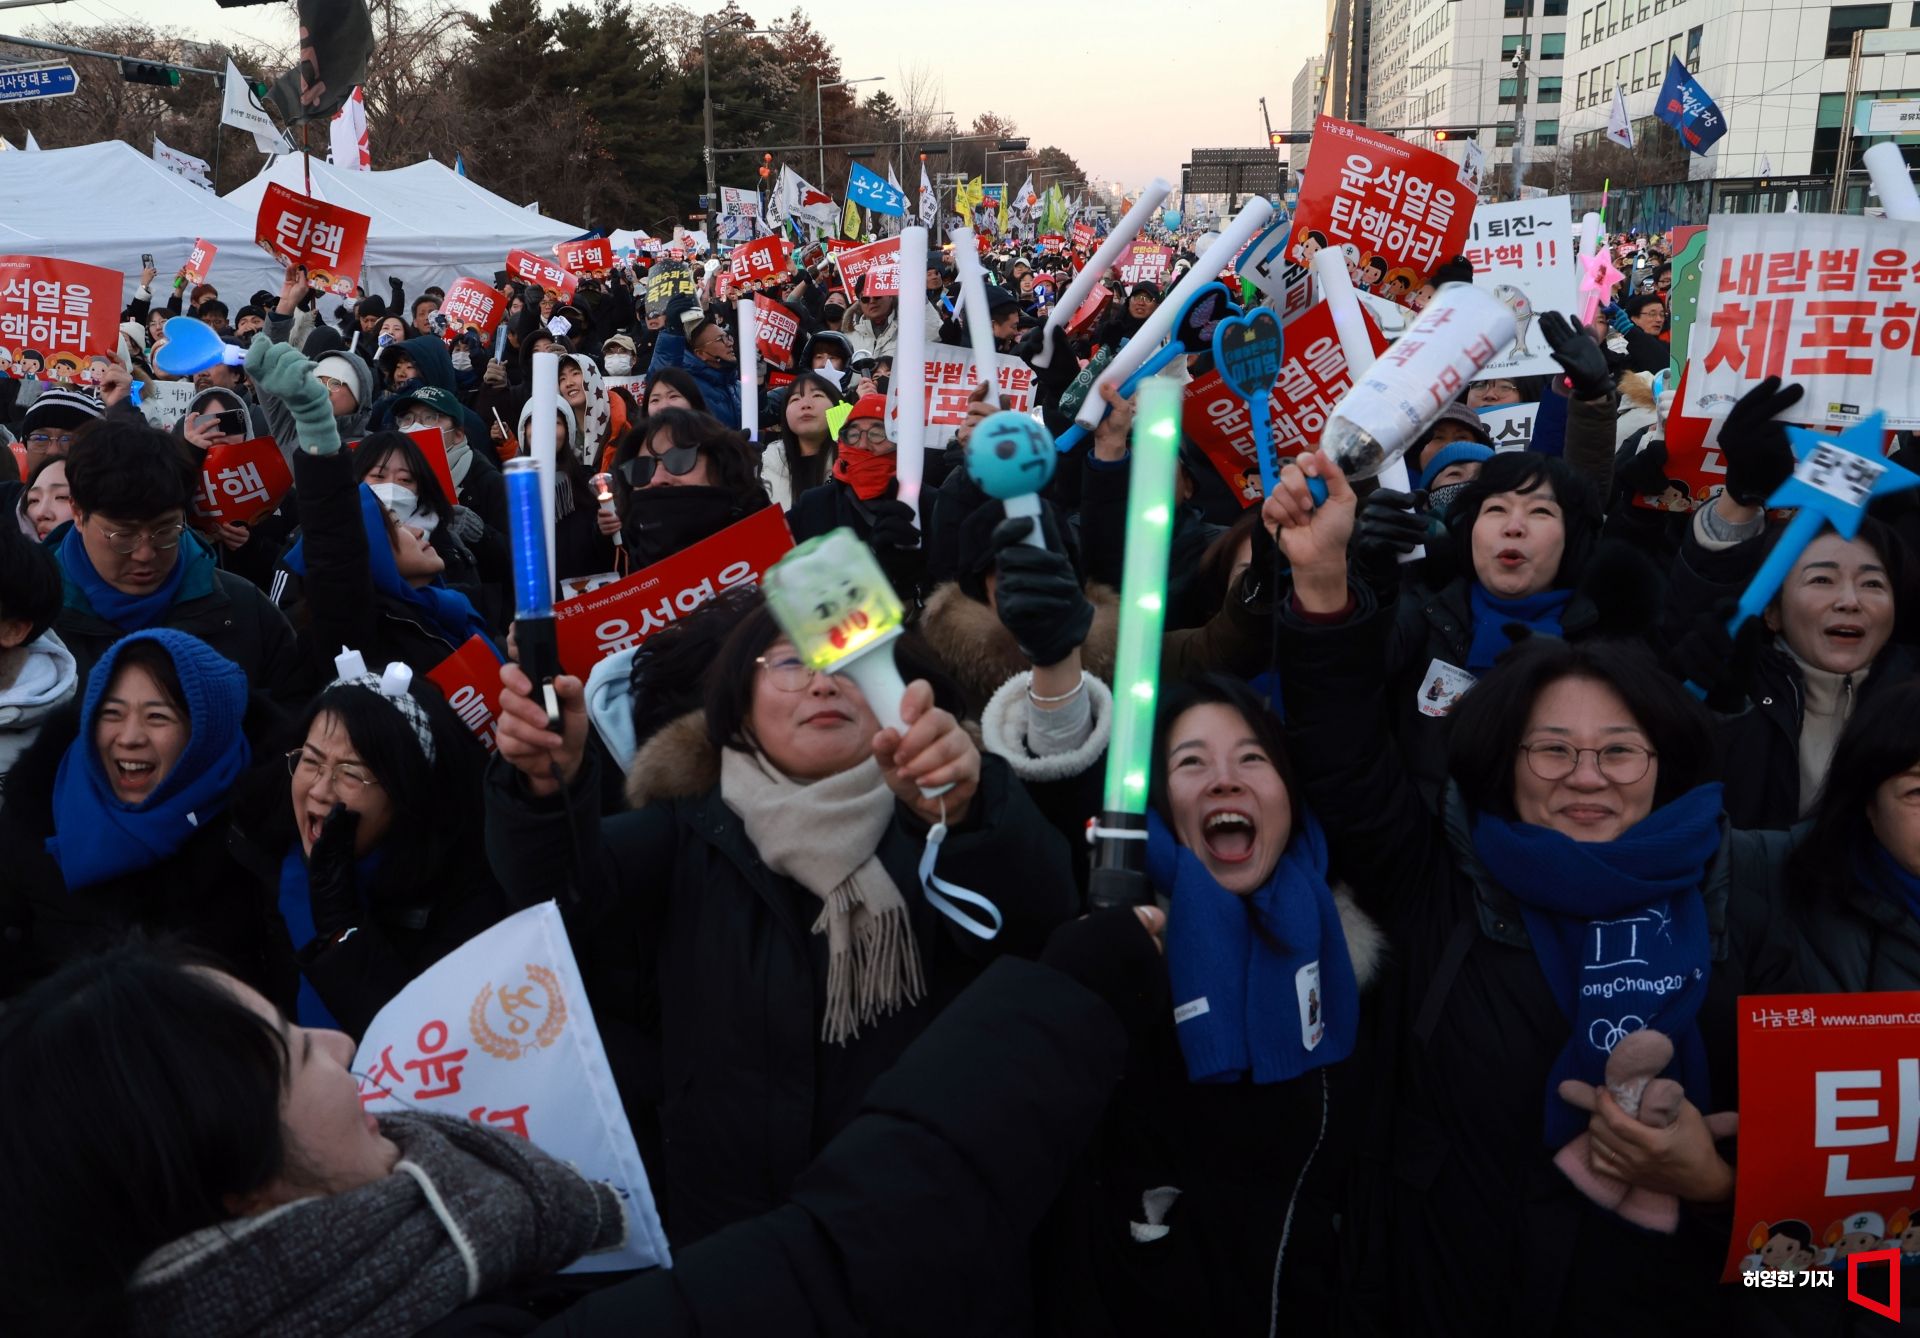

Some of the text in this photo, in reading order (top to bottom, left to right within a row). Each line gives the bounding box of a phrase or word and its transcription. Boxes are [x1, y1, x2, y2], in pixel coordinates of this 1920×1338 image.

[1355, 135, 1410, 158] www.nanum.com
[1340, 154, 1456, 232] 윤석열을
[275, 210, 345, 268] 탄핵
[1329, 195, 1443, 273] 탄핵하라
[519, 257, 565, 287] 탄핵
[567, 247, 603, 270] 탄핵
[732, 247, 774, 281] 탄핵
[844, 257, 878, 275] 내란수괴
[1134, 253, 1167, 265] 윤석열
[1466, 243, 1523, 273] 탄핵
[924, 361, 964, 385] 란범
[586, 576, 660, 611] www.nanum.com
[1752, 1007, 1817, 1028] 나눔문화
